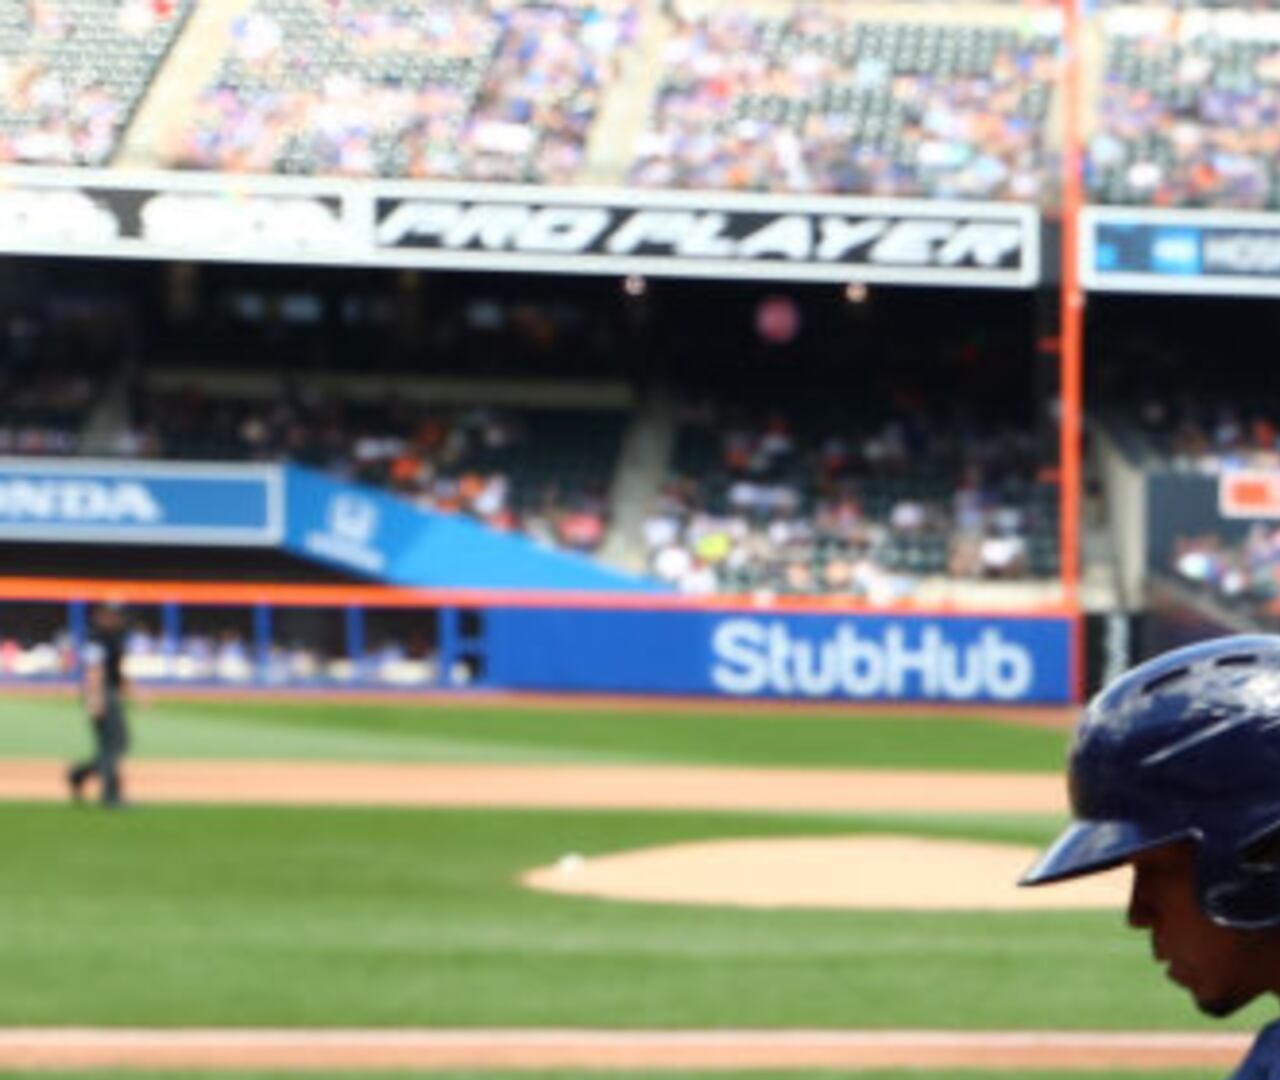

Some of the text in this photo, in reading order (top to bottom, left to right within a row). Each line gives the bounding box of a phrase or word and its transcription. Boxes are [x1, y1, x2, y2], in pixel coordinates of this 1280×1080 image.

[374, 200, 610, 251] PRO
[605, 208, 1022, 267] PLAYER
[0, 479, 162, 523] NDA
[711, 617, 1033, 699] StubHub
